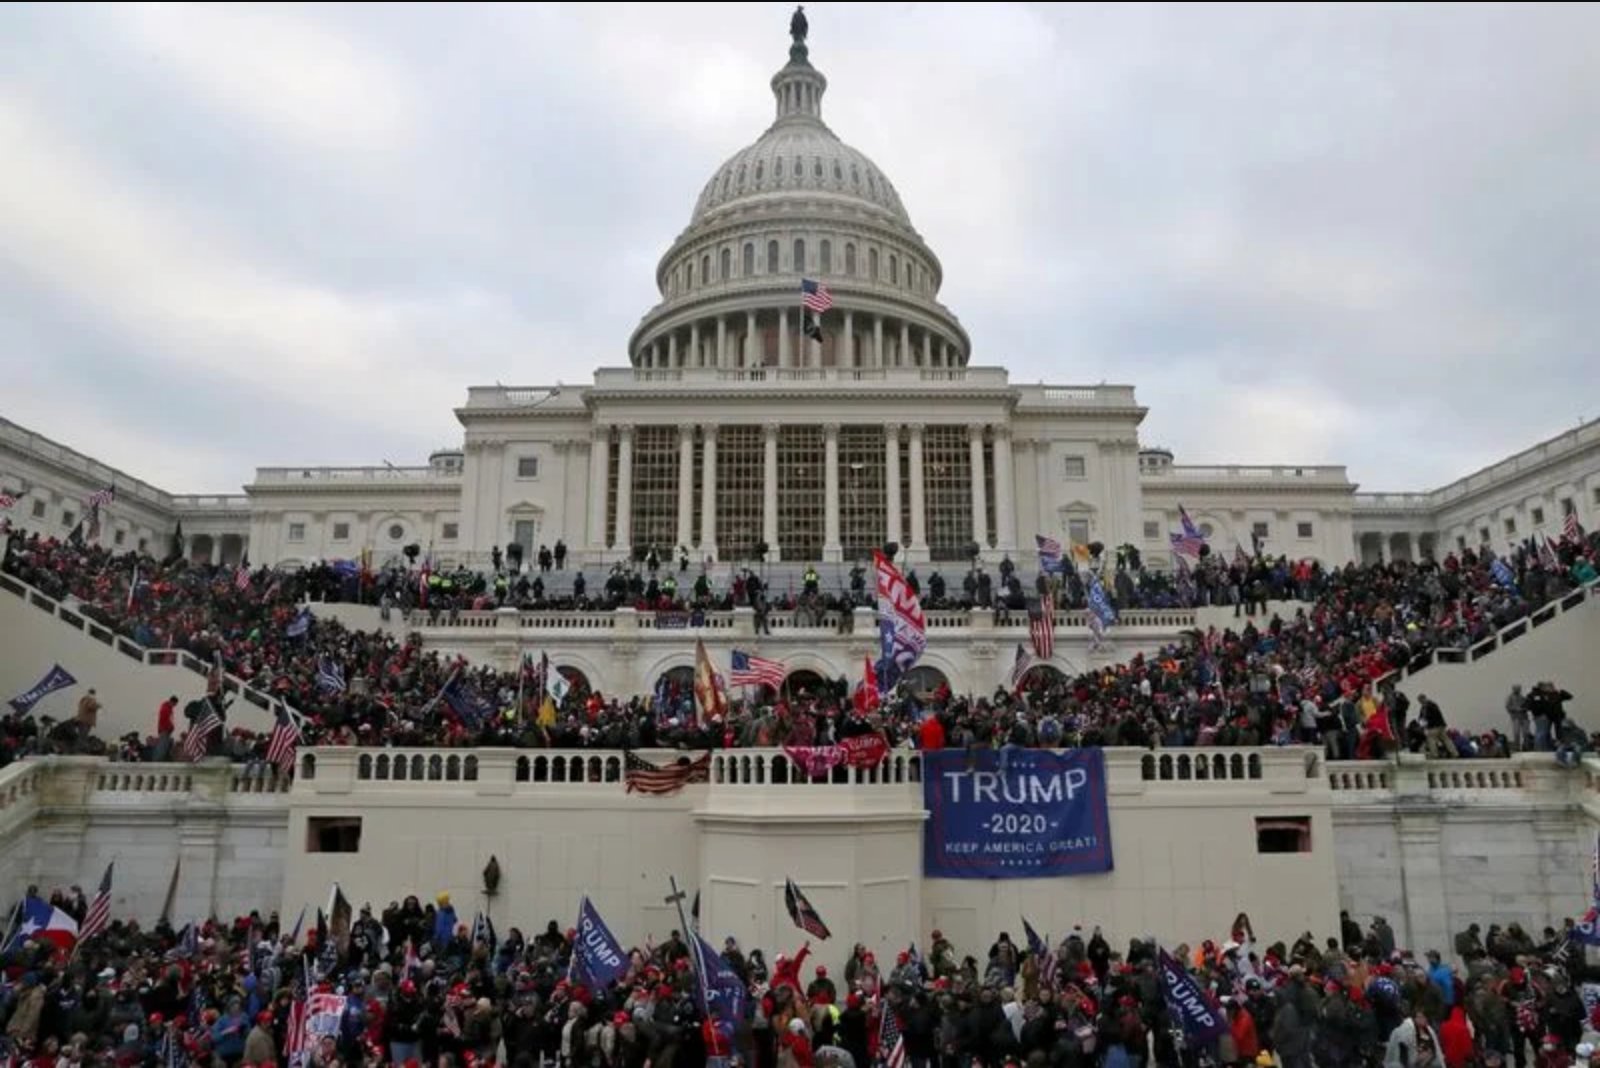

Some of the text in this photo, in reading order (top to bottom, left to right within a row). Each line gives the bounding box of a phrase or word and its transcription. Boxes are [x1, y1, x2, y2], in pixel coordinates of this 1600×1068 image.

[944, 769, 1087, 804] TRUMP
[945, 836, 1097, 854] KEEP AMERICA GREAT!
[1163, 965, 1215, 1027] RUMP
